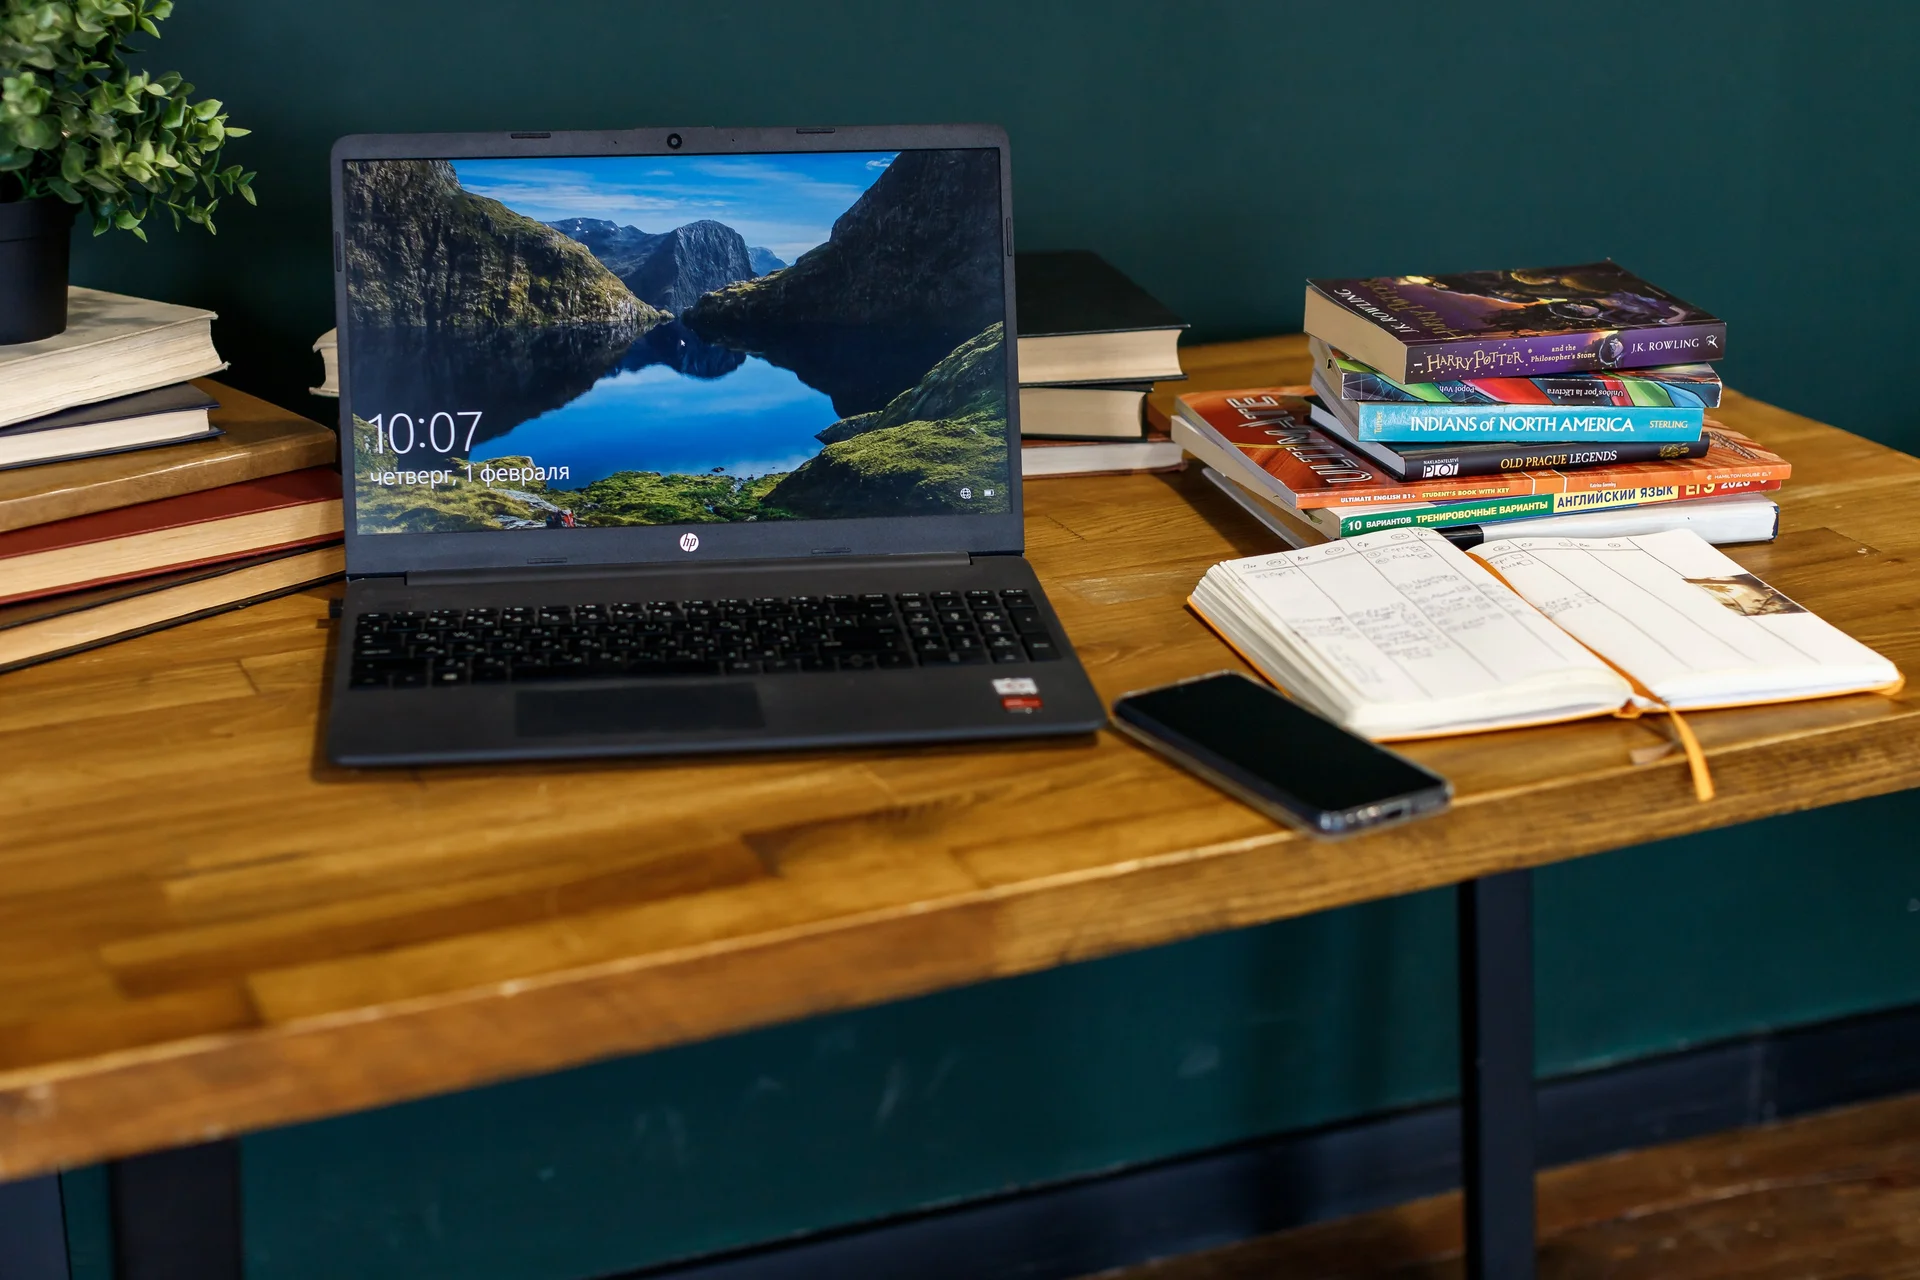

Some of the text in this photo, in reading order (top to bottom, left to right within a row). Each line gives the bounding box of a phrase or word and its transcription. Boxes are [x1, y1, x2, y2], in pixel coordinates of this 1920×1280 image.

[1334, 288, 1397, 323] ROWLING
[1551, 343, 1577, 353] and the
[1630, 338, 1700, 354] J.K. ROWLING
[1427, 349, 1525, 373] HARRY POTTER
[1530, 351, 1596, 363] Philosopher's Stone
[1575, 388, 1583, 396] la
[1584, 385, 1597, 396] por
[1410, 416, 1635, 432] INDIANS of NORTH AMERICA
[1649, 420, 1688, 429] STERLING
[367, 411, 483, 455] 10:07
[1500, 450, 1618, 469] OLD PRAGUE LEGENDS
[369, 463, 570, 489] четверг, 1 февраля
[1422, 463, 1459, 478] PLOT
[1373, 494, 1401, 502] ENGLISH
[1421, 490, 1457, 498] STUDENT'S
[1639, 486, 1674, 499] ЯЗЫК
[1415, 501, 1548, 524] ТРЕНИРОВОЧНЫЕ ВАРИАНТЫ
[1348, 516, 1412, 531] 10 ВАРИАНТОВ
[680, 533, 699, 552] hp
